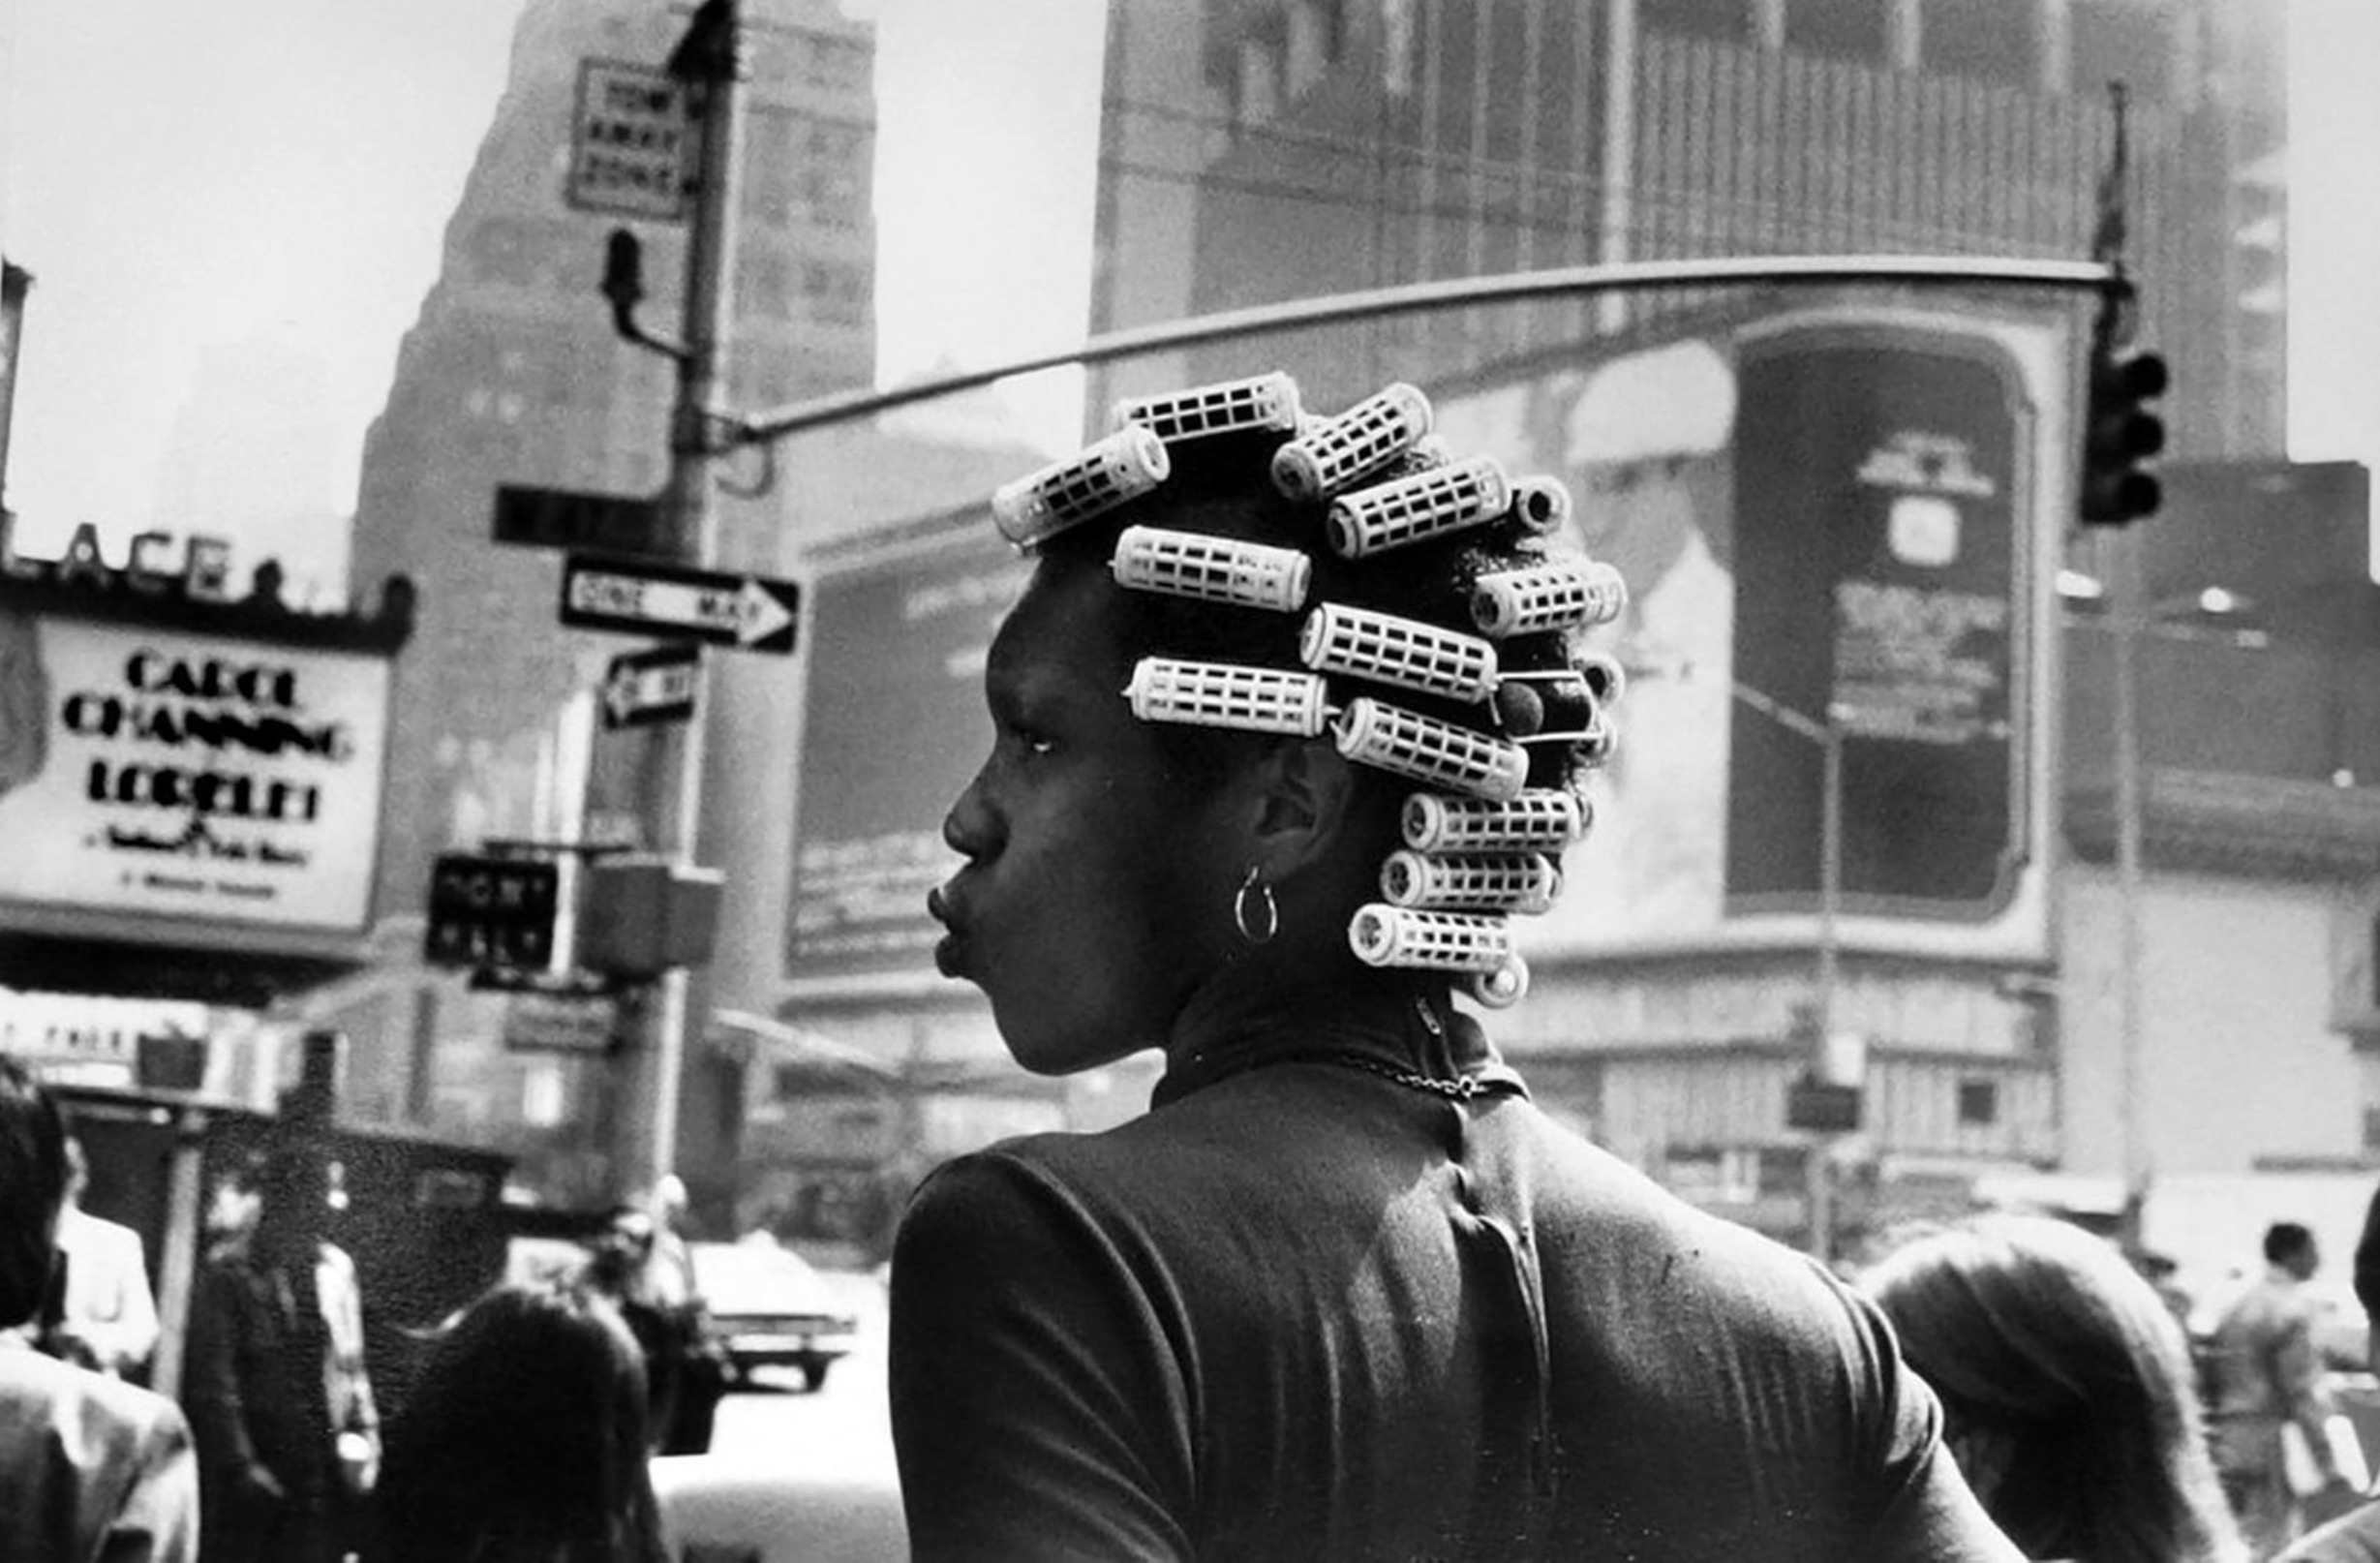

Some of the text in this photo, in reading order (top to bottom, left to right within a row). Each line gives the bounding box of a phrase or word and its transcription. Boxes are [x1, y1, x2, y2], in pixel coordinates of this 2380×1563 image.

[583, 572, 763, 629] ONE WAY
[127, 646, 302, 713] CAROL
[62, 690, 354, 764] CHANNING
